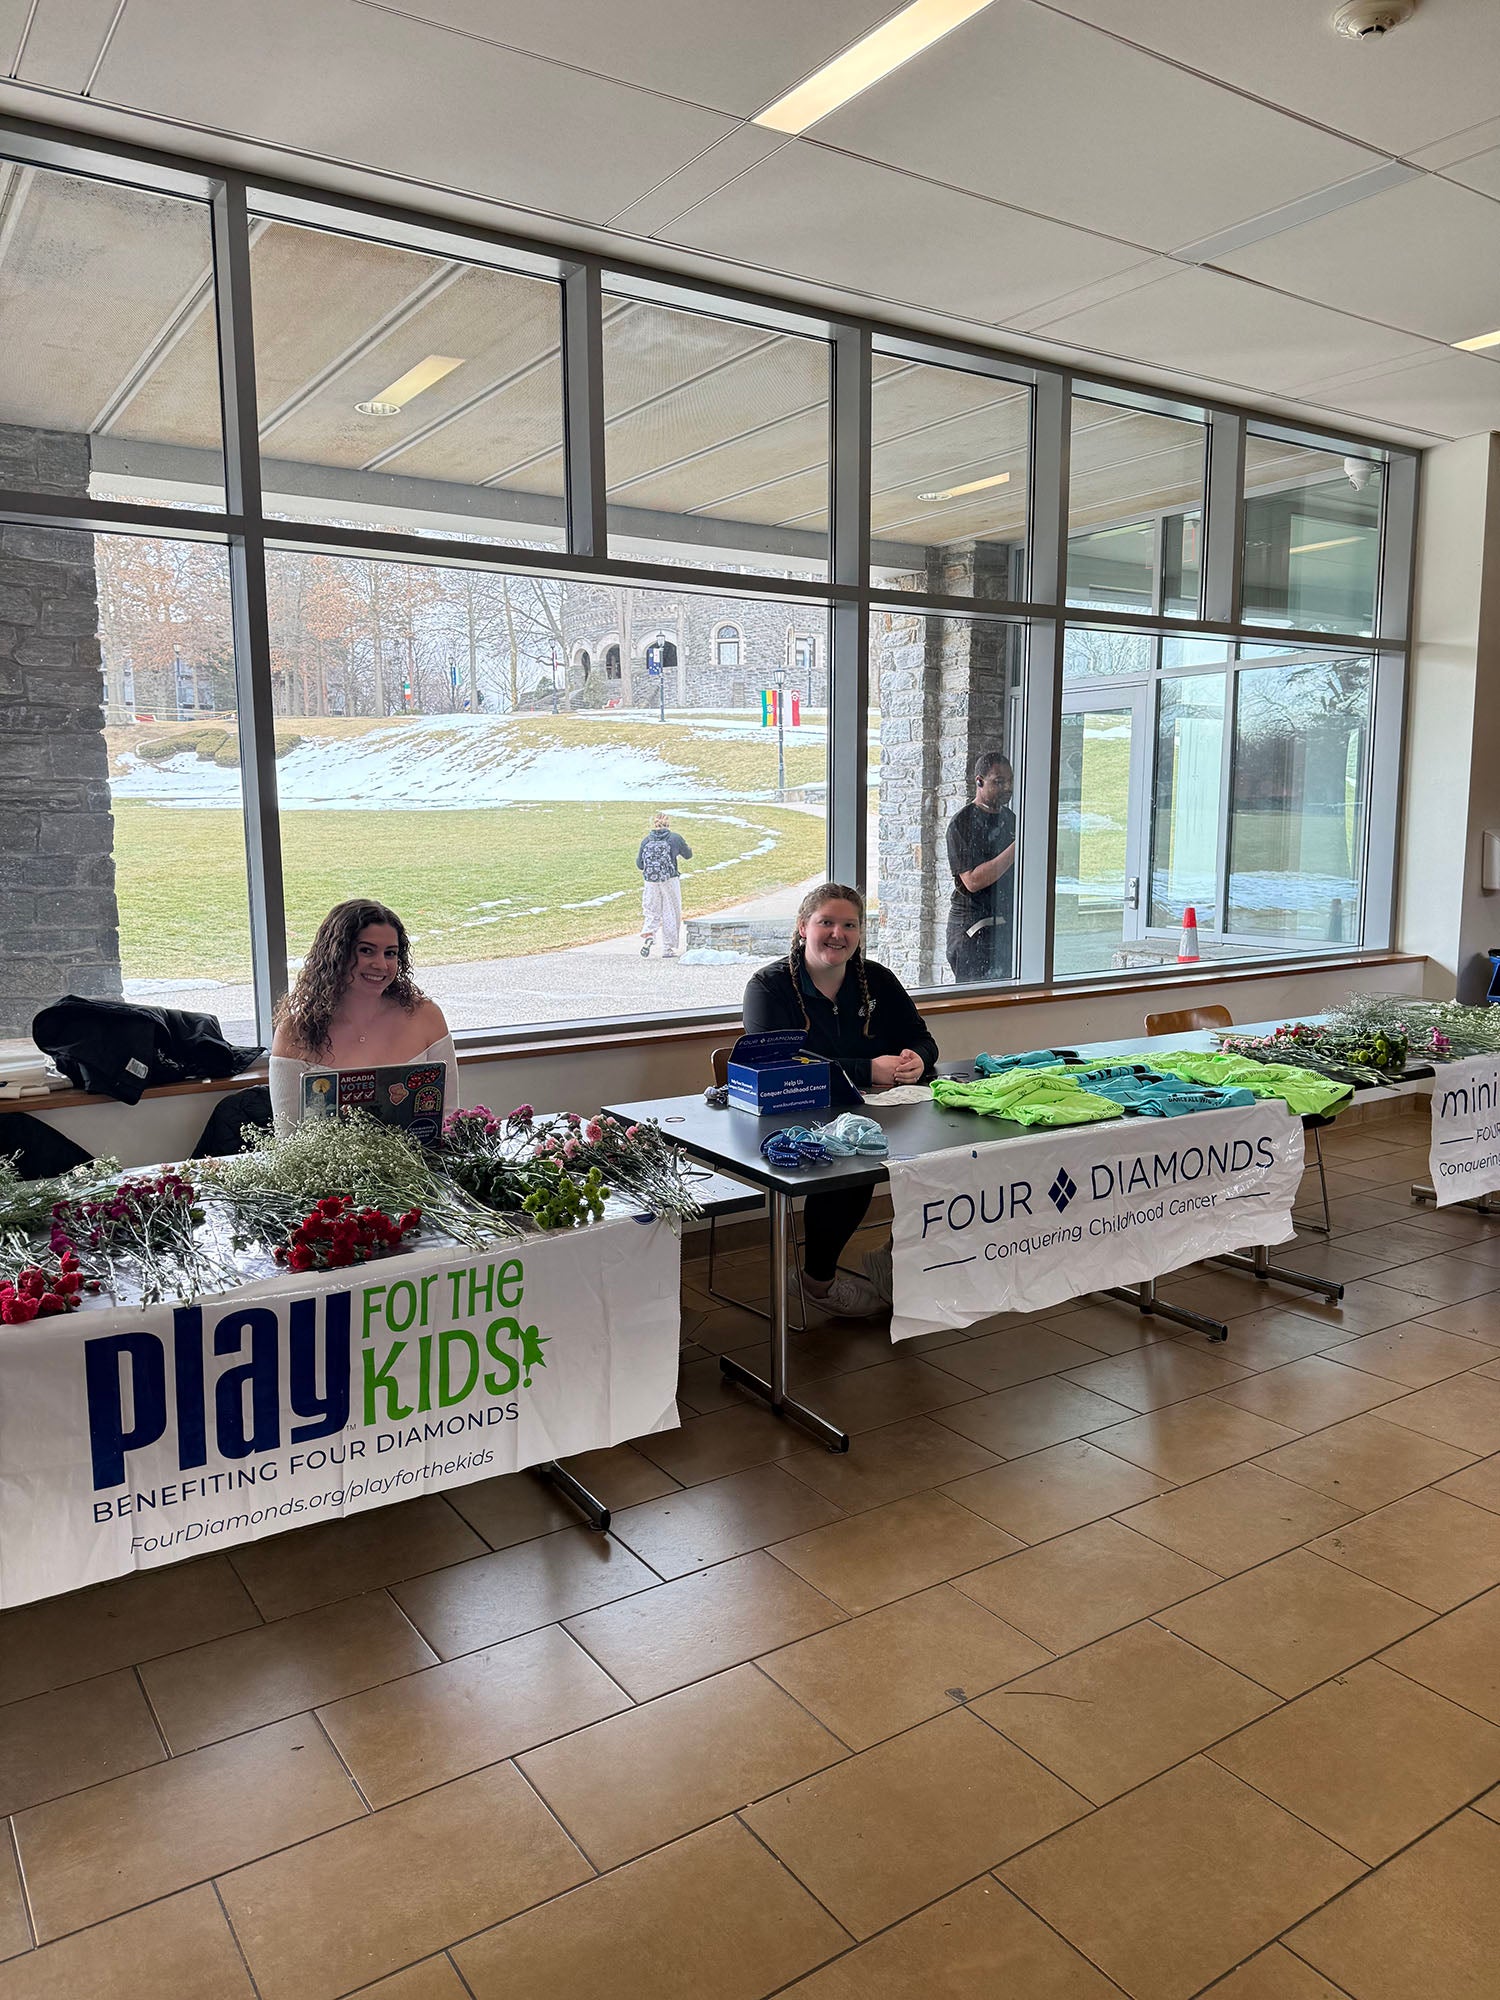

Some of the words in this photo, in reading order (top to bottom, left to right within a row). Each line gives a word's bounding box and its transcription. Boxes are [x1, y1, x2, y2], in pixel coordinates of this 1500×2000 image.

[766, 1035, 805, 1043] DIAMONDS
[340, 1074, 375, 1084] ARCADIA
[340, 1081, 375, 1092] VOTES
[760, 1090, 782, 1098] Conquer
[782, 1086, 809, 1095] Childhood
[809, 1084, 827, 1092] Cancer
[1439, 1152, 1500, 1177] Conquerin
[921, 1181, 1033, 1239] FOUR
[1091, 1136, 1275, 1201] DIAMONDS
[984, 1225, 1082, 1261] Conquering
[1088, 1201, 1164, 1236] Childhood
[1168, 1193, 1218, 1216] Cancer
[93, 1461, 279, 1524] BENEFITING
[289, 1440, 366, 1475] FOUR
[376, 1402, 520, 1454] DIAMONDS
[130, 1448, 495, 1555] FourDiamonds.org/playforthekids
